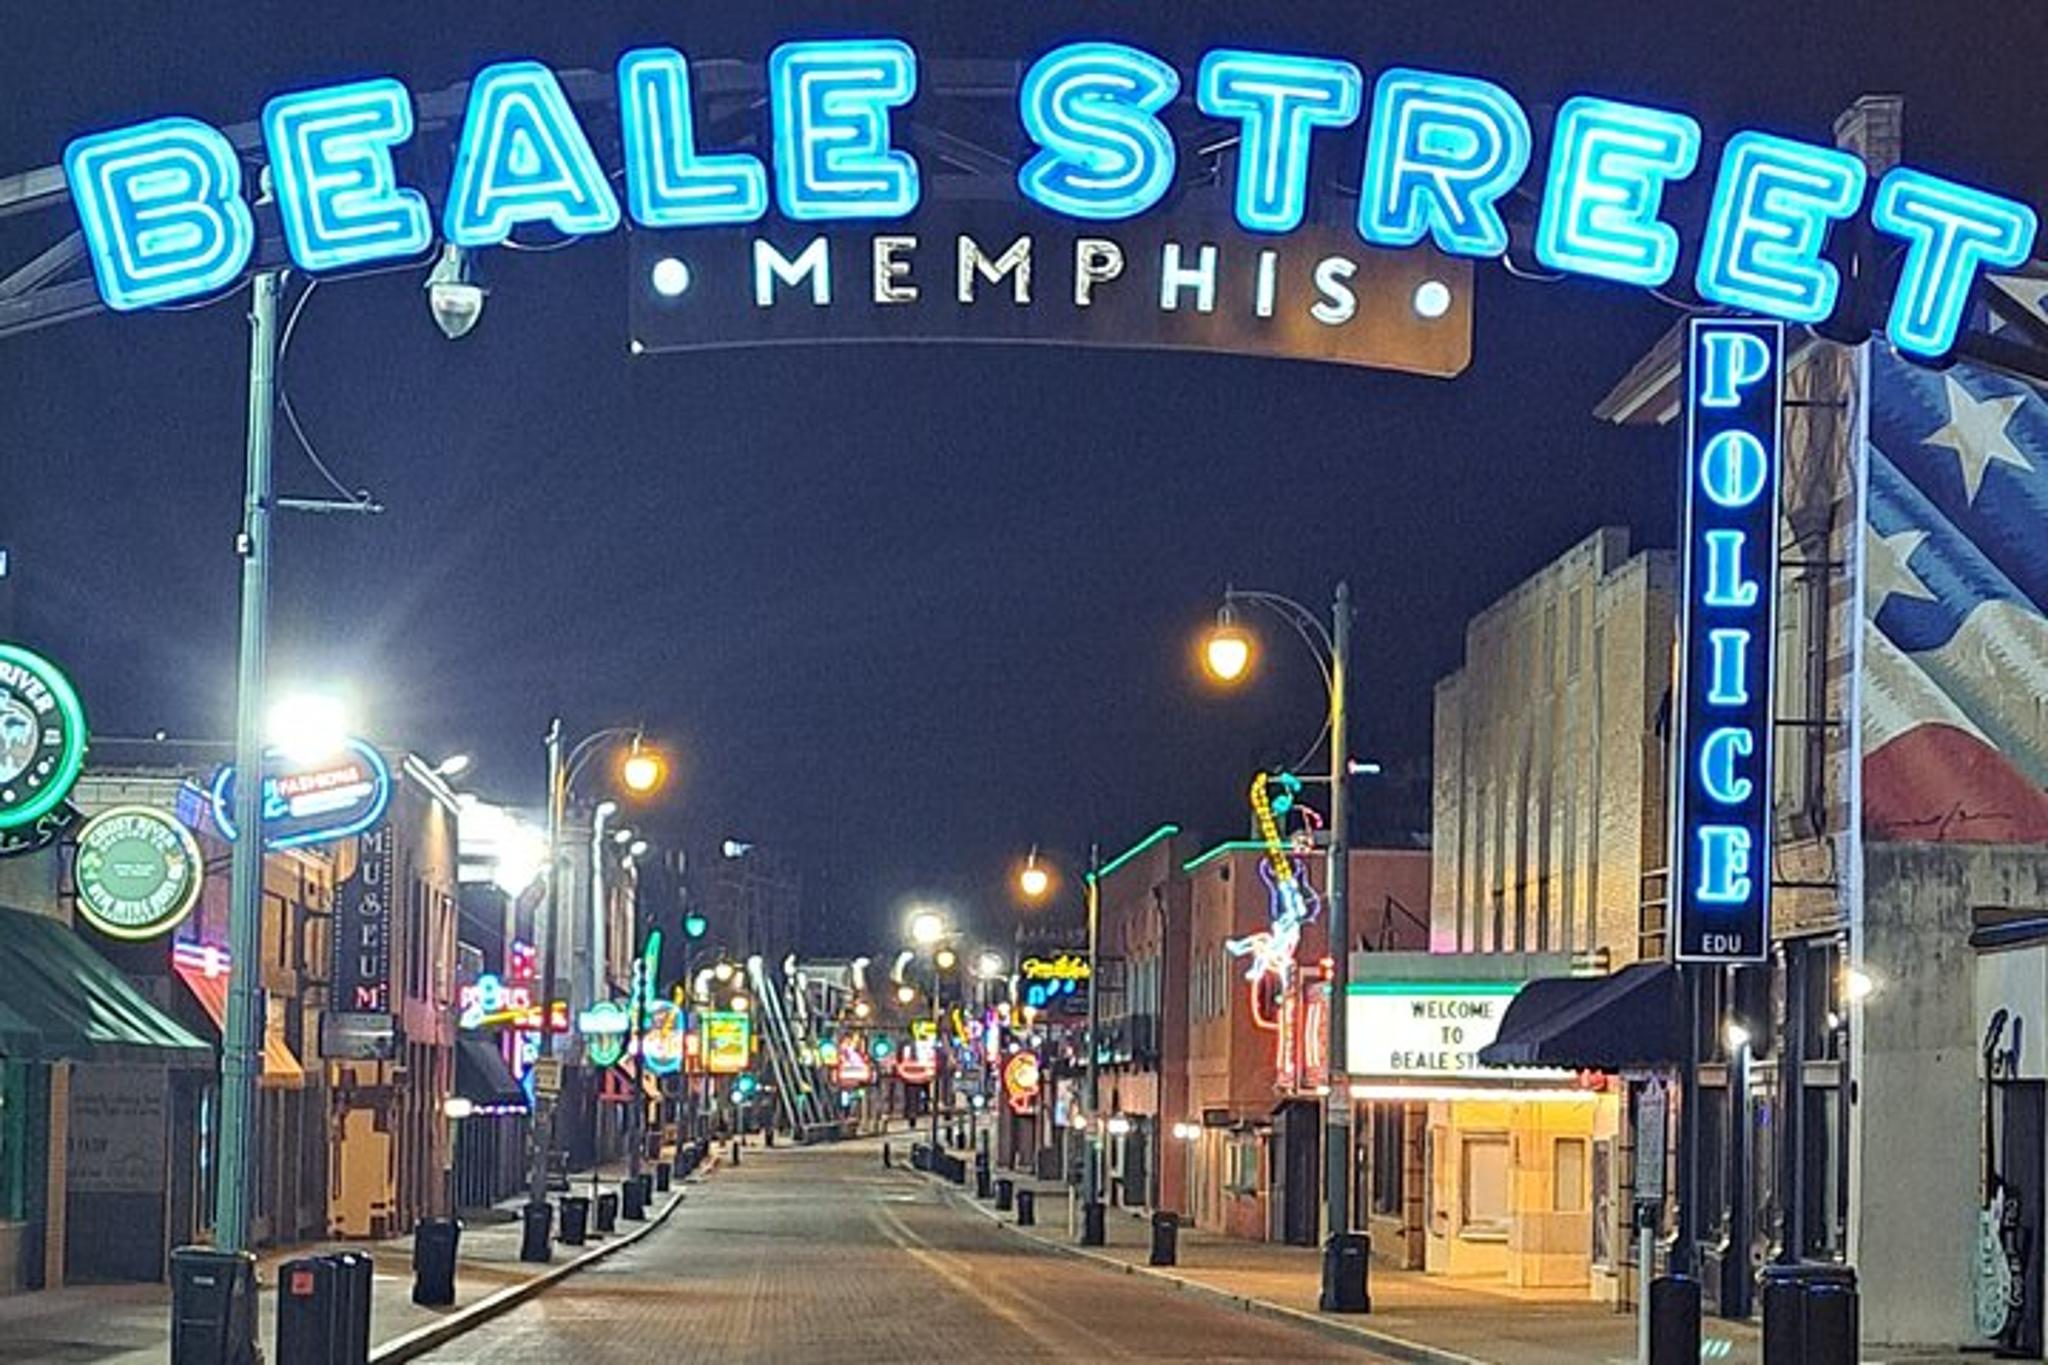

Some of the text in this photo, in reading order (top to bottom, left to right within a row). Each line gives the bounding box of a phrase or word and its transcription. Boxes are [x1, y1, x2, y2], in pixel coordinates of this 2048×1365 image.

[64, 38, 2038, 358] BEALE STREET
[753, 236, 1359, 325] MEMPHIS
[1697, 330, 1771, 906] POLICE
[356, 830, 383, 1010] MUSEUM
[1702, 933, 1742, 954] EDU
[1411, 1000, 1494, 1020] WELCOME
[1441, 1026, 1464, 1045] TO
[1390, 1051, 1450, 1070] BEALE
